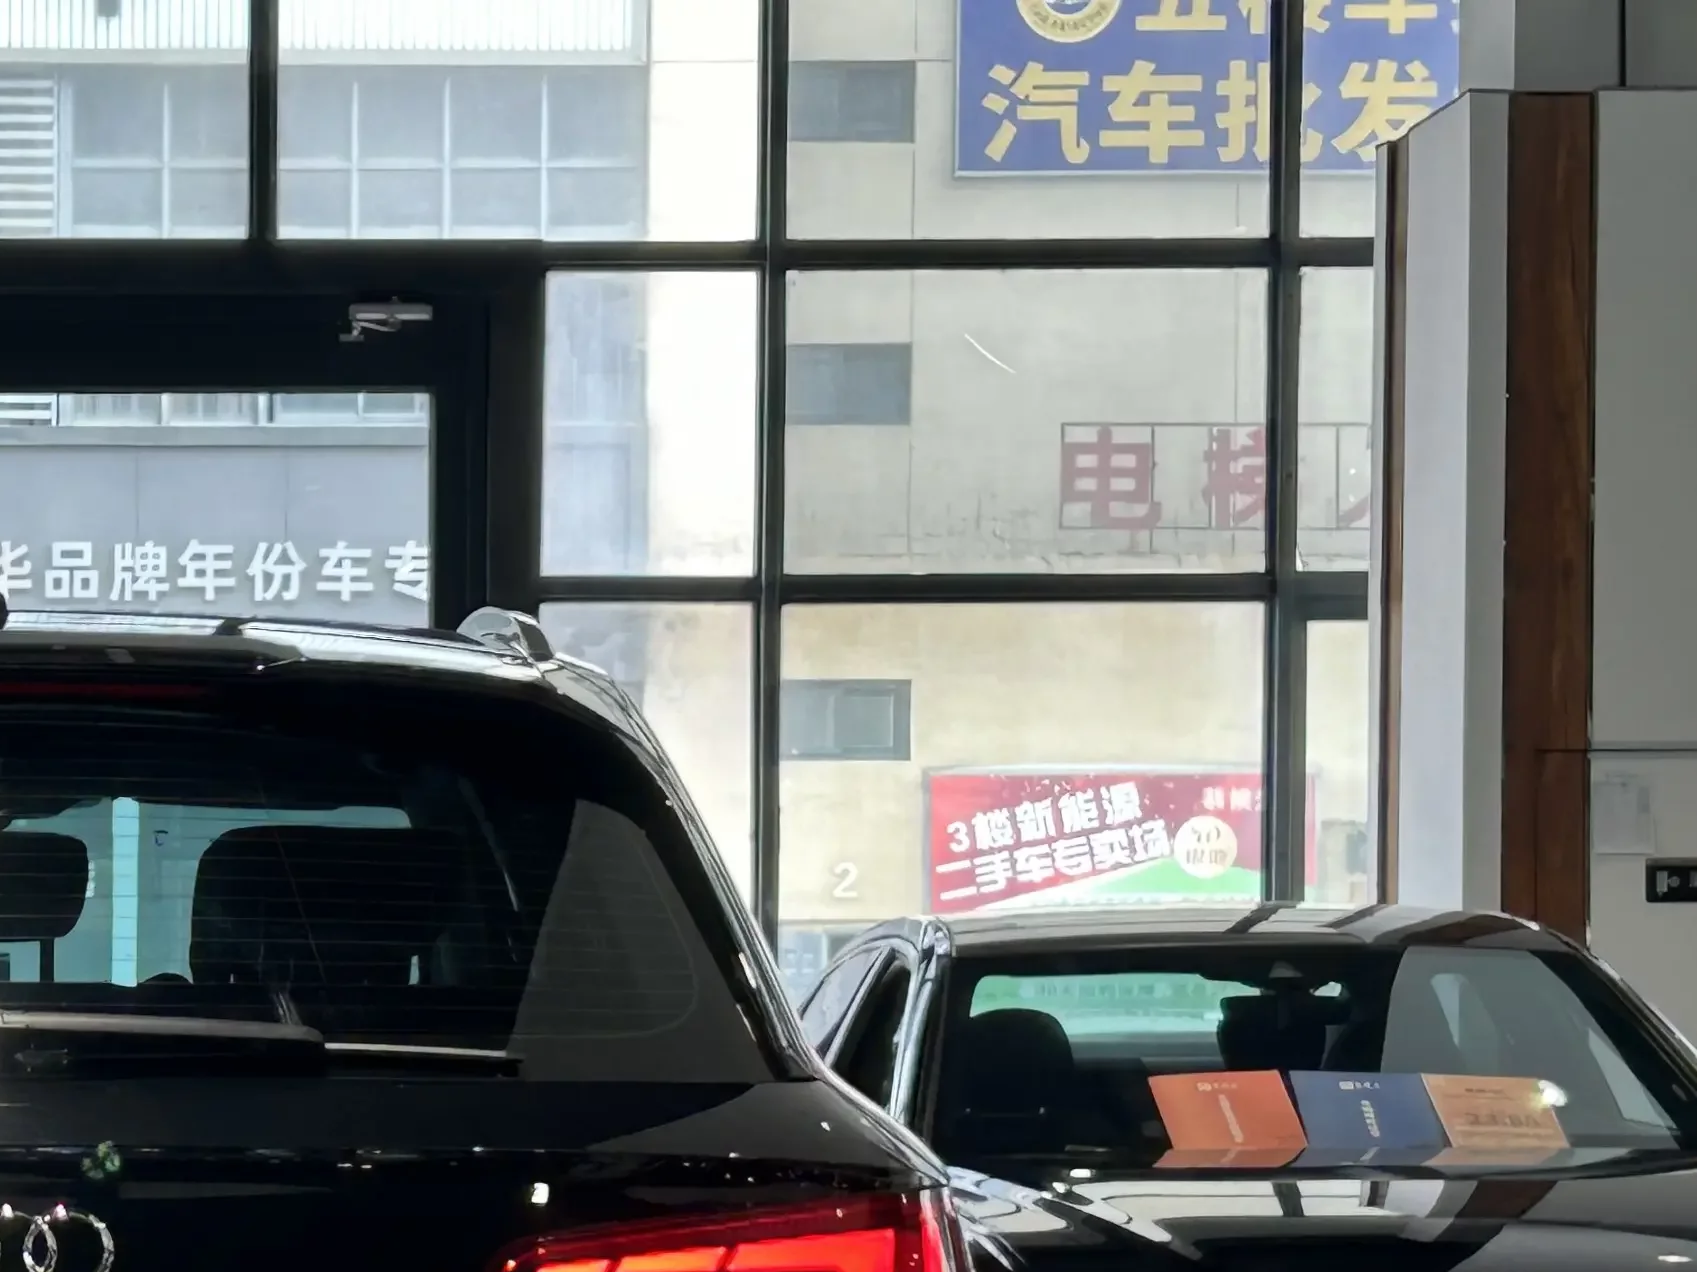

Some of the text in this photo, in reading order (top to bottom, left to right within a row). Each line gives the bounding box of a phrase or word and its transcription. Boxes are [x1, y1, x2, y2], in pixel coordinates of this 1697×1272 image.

[982, 60, 1440, 164] 汽车批发
[832, 861, 858, 897] 2
